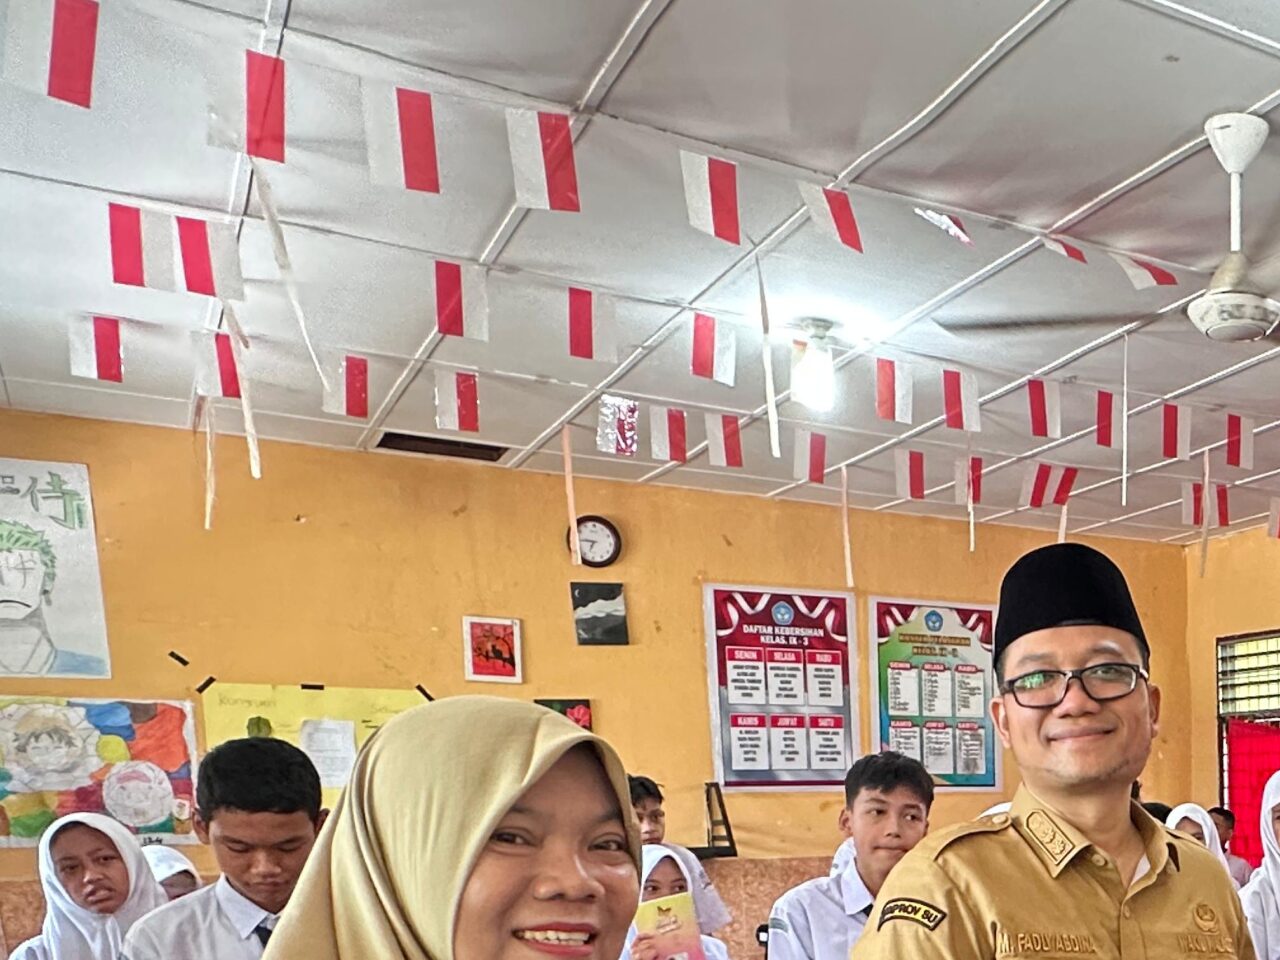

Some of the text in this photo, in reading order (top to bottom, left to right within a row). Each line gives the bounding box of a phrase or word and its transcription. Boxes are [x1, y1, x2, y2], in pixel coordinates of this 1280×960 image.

[743, 624, 825, 637] DAFTAR KEBERSIHAN
[922, 910, 939, 923] SU
